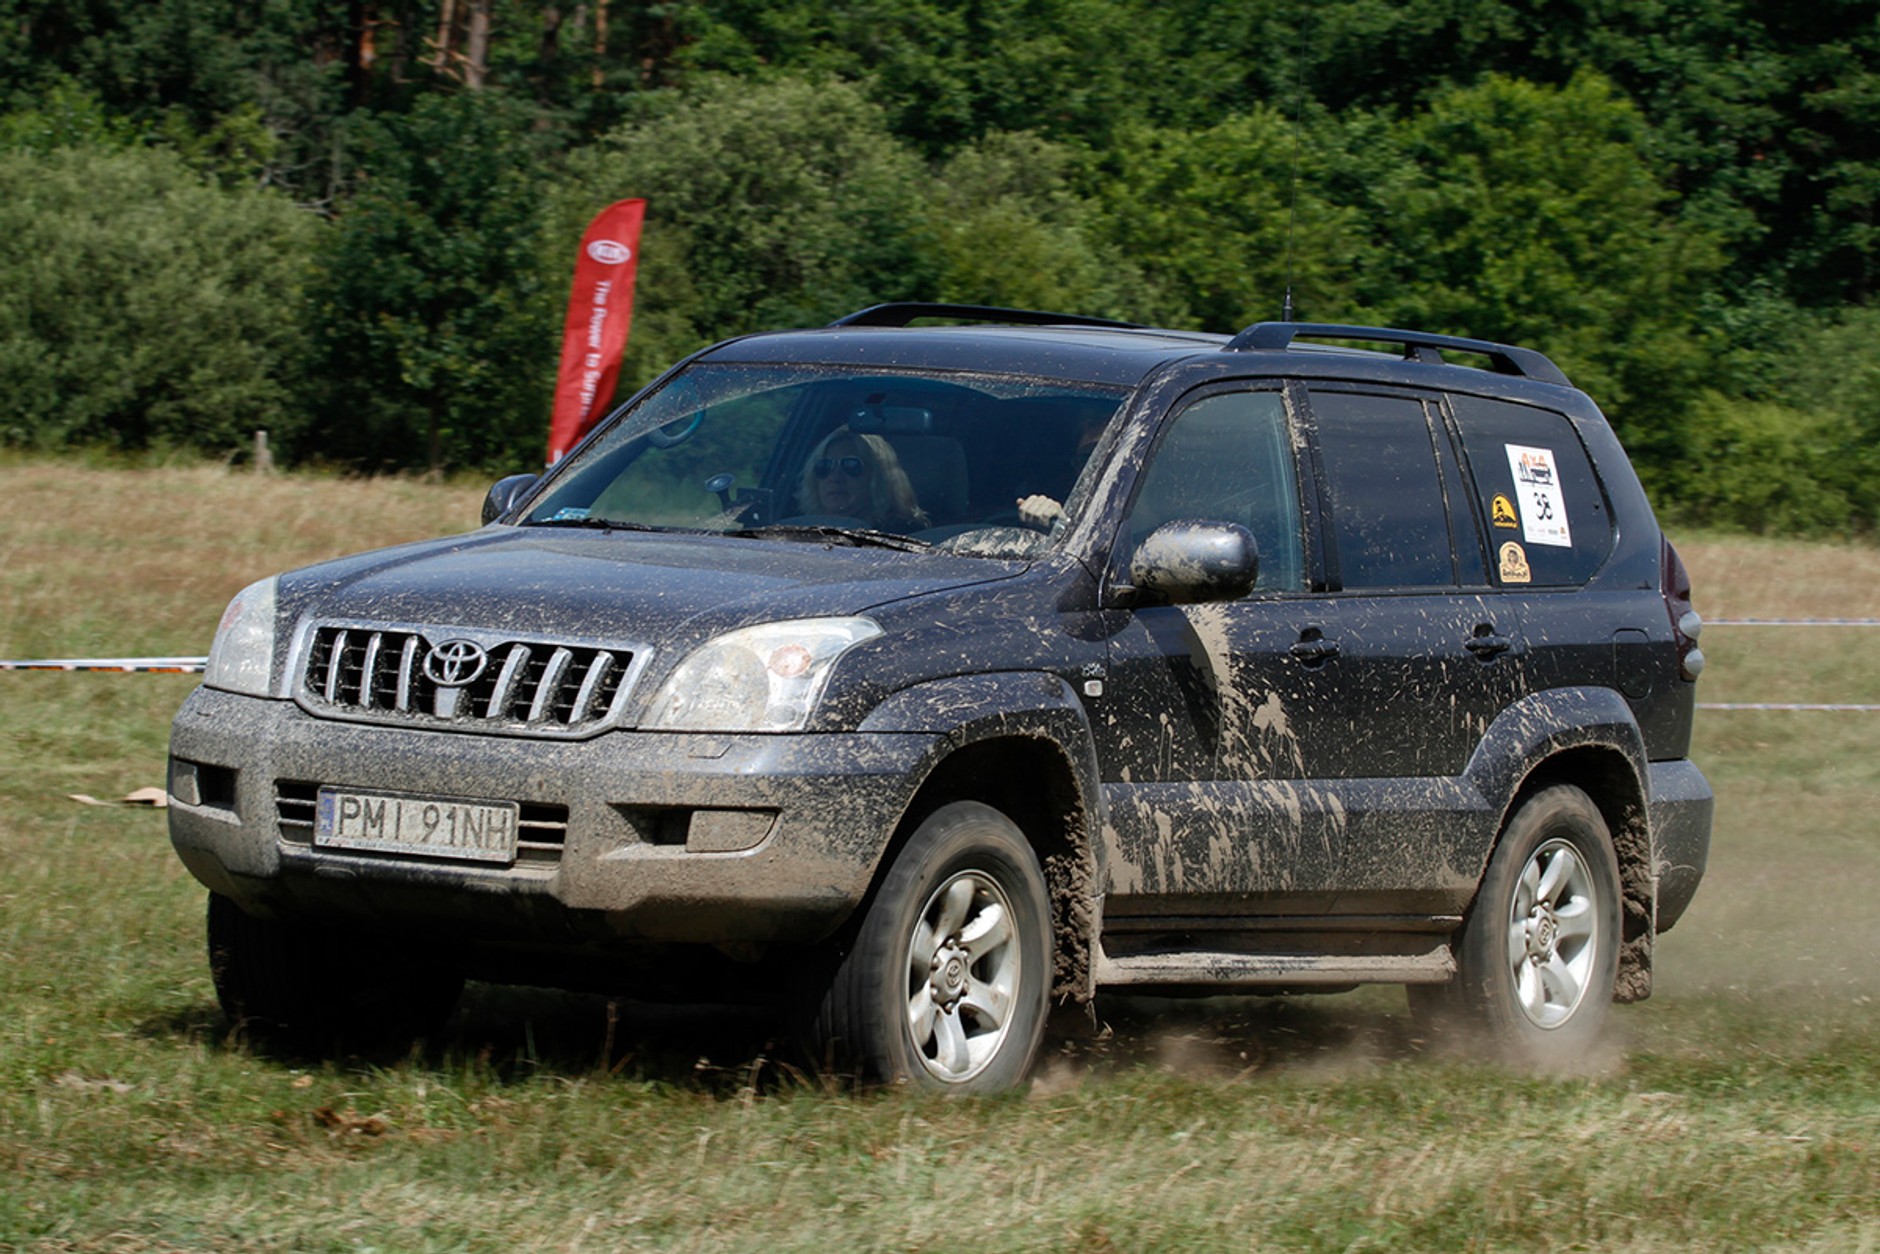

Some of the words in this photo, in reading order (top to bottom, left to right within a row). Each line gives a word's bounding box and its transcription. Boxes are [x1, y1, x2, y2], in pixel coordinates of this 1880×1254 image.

[592, 280, 612, 305] The
[587, 307, 608, 349] Power
[585, 353, 603, 368] to
[338, 795, 402, 840] PMI
[420, 804, 508, 850] 91NH
